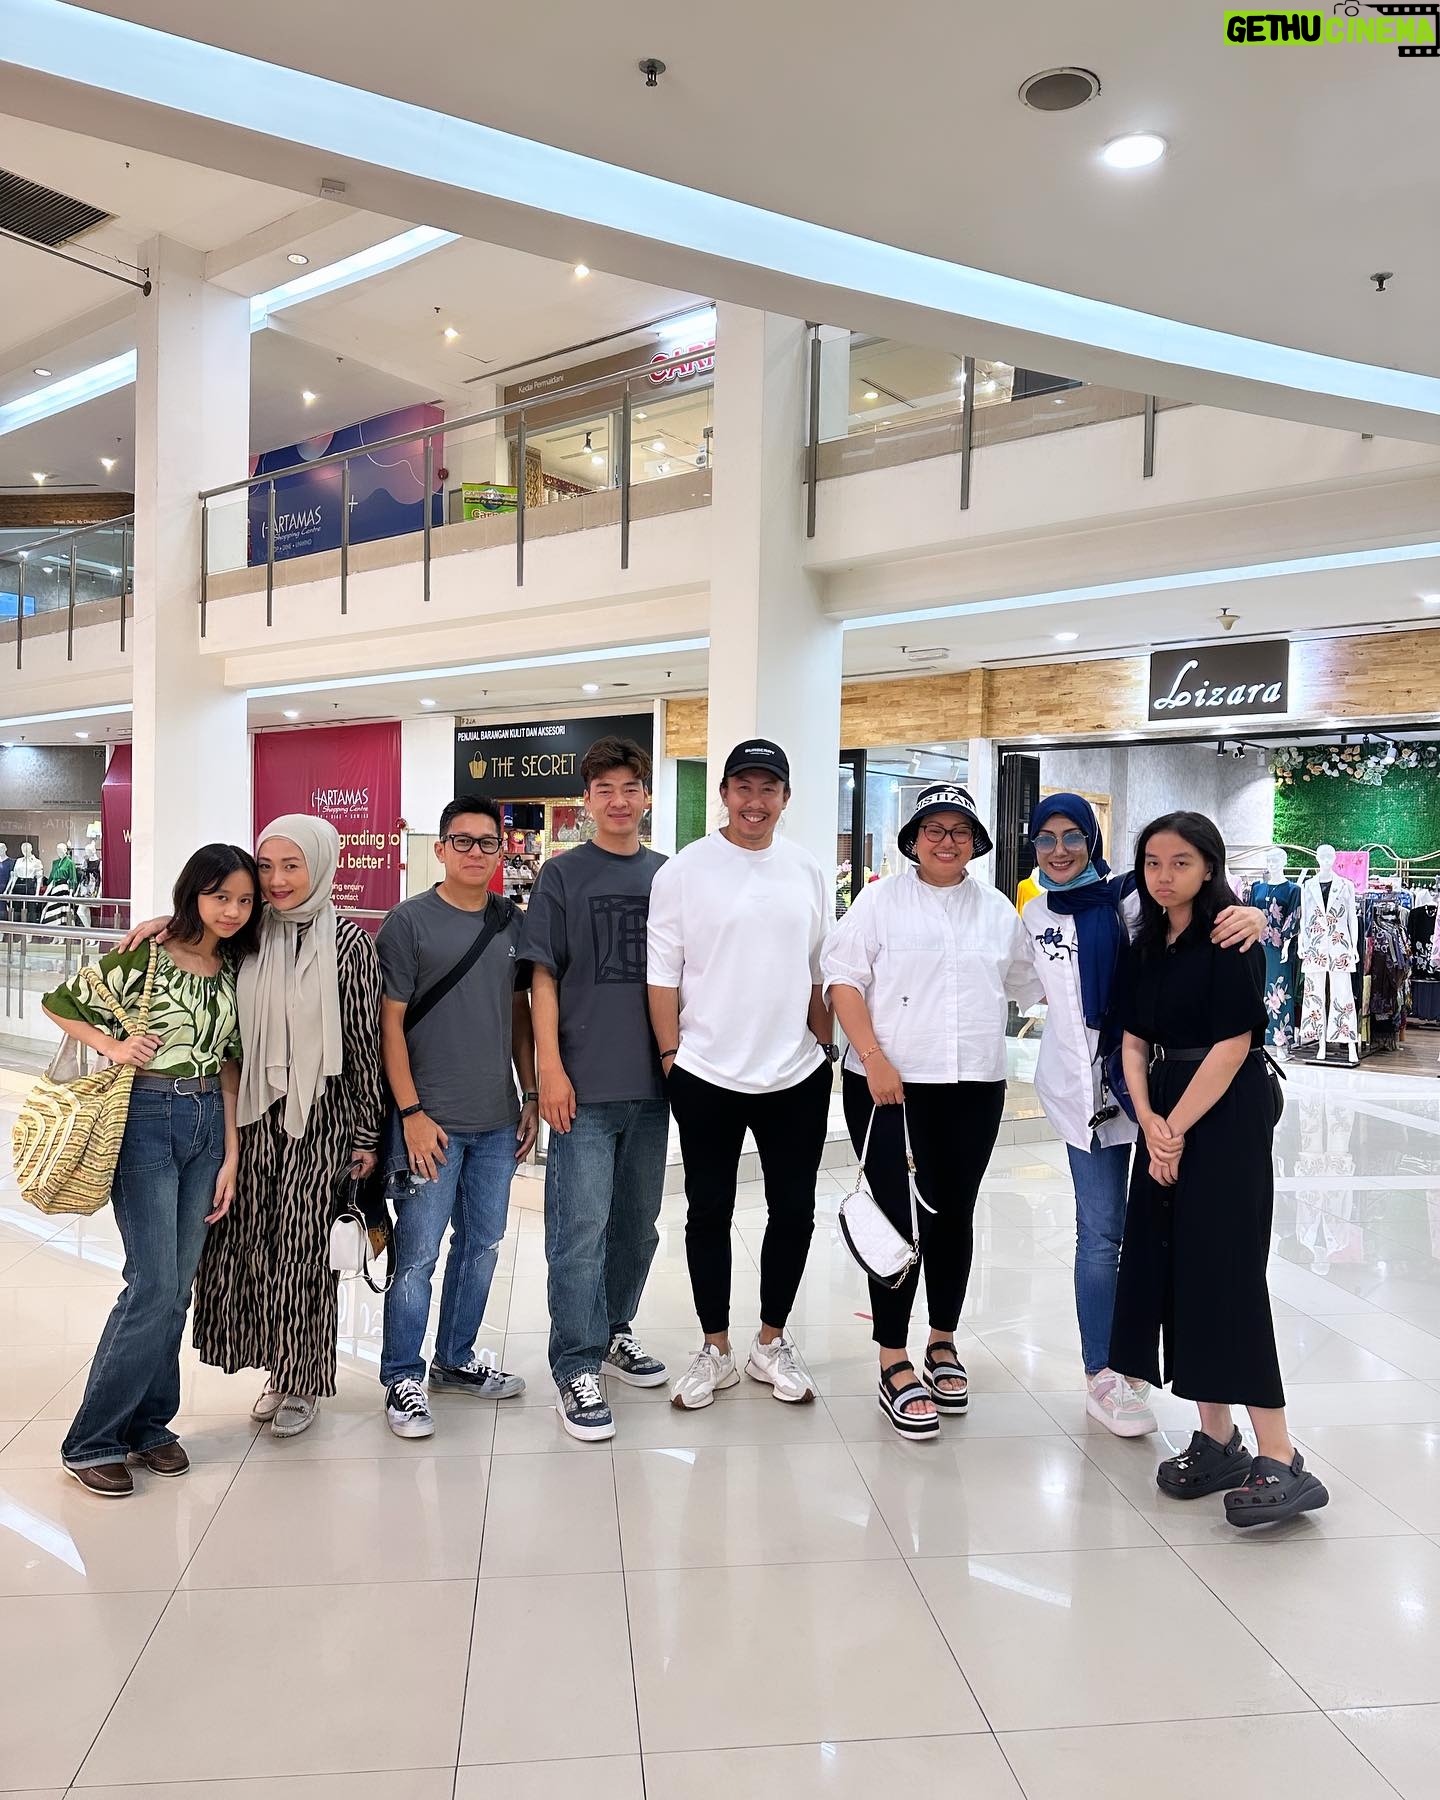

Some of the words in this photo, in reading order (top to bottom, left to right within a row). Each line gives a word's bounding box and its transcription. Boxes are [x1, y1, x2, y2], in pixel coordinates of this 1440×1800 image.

[301, 526, 321, 536] Centre
[1153, 659, 1282, 710] Lizara
[457, 732, 480, 742] PENJUAL
[480, 730, 509, 740] BARANGAN
[509, 728, 526, 738] KULIT
[526, 727, 538, 737] DAN
[538, 725, 566, 736] AKSESORI
[491, 756, 515, 778] THE
[521, 753, 577, 777] SECRET
[311, 788, 369, 812] HARTAMAS
[322, 805, 348, 814] Shopping
[349, 804, 369, 813] Centre
[339, 830, 385, 850] grading
[347, 853, 384, 869] better
